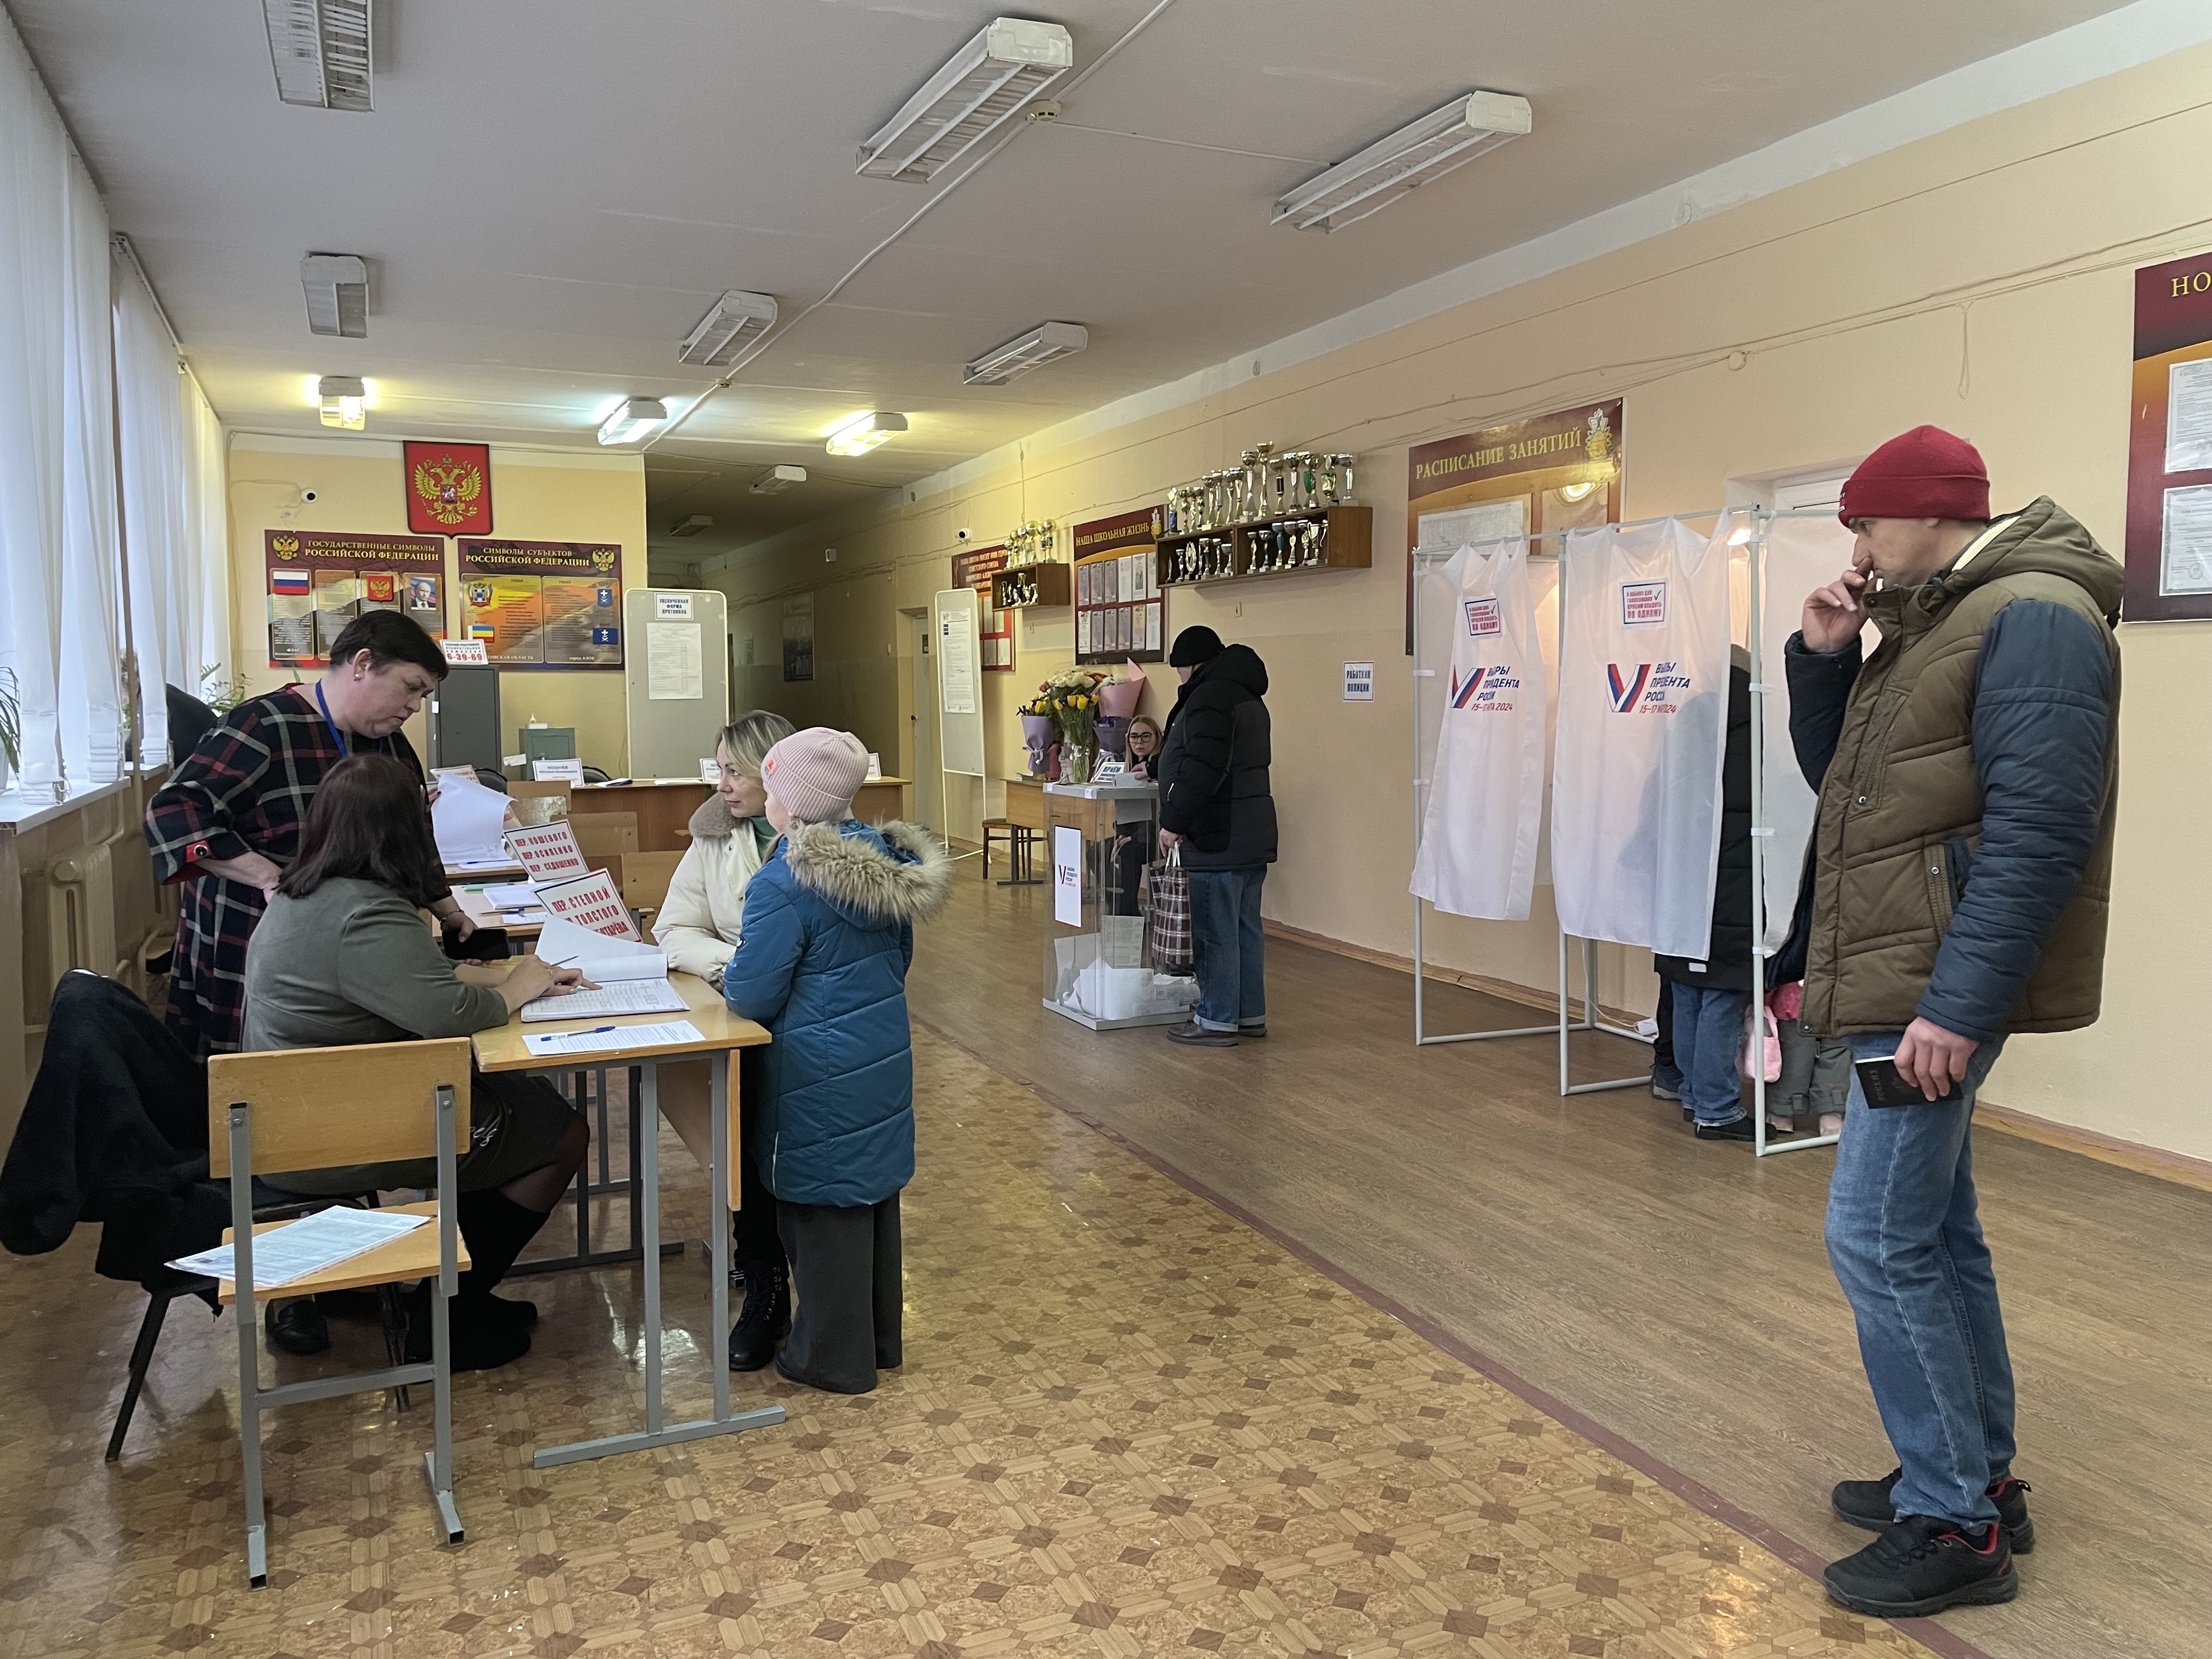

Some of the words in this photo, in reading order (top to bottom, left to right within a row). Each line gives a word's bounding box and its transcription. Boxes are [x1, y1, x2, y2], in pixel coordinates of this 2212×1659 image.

[1416, 447, 1504, 479] РАСПИСАНИЕ
[1509, 427, 1582, 460] ЗАНЯТИЙ
[1076, 537, 1093, 546] НАША
[1093, 527, 1126, 543] ШКОЛЬНАЯ
[1126, 522, 1149, 537] ЖИЗНЬ
[308, 540, 391, 550] ГОСУДАРСТВЕННЫЕ
[393, 544, 435, 552] СИМВОЛЫ
[305, 549, 376, 558] РОССИЙСКОЙ
[378, 551, 439, 561] ФЕДЕРАЦИИ
[466, 555, 531, 564] РОССИЙСКОЙ
[533, 557, 589, 566] ФЕДЕРАЦИИ
[1495, 703, 1513, 711] 2024
[575, 905, 619, 926] ТОЛСТОГО
